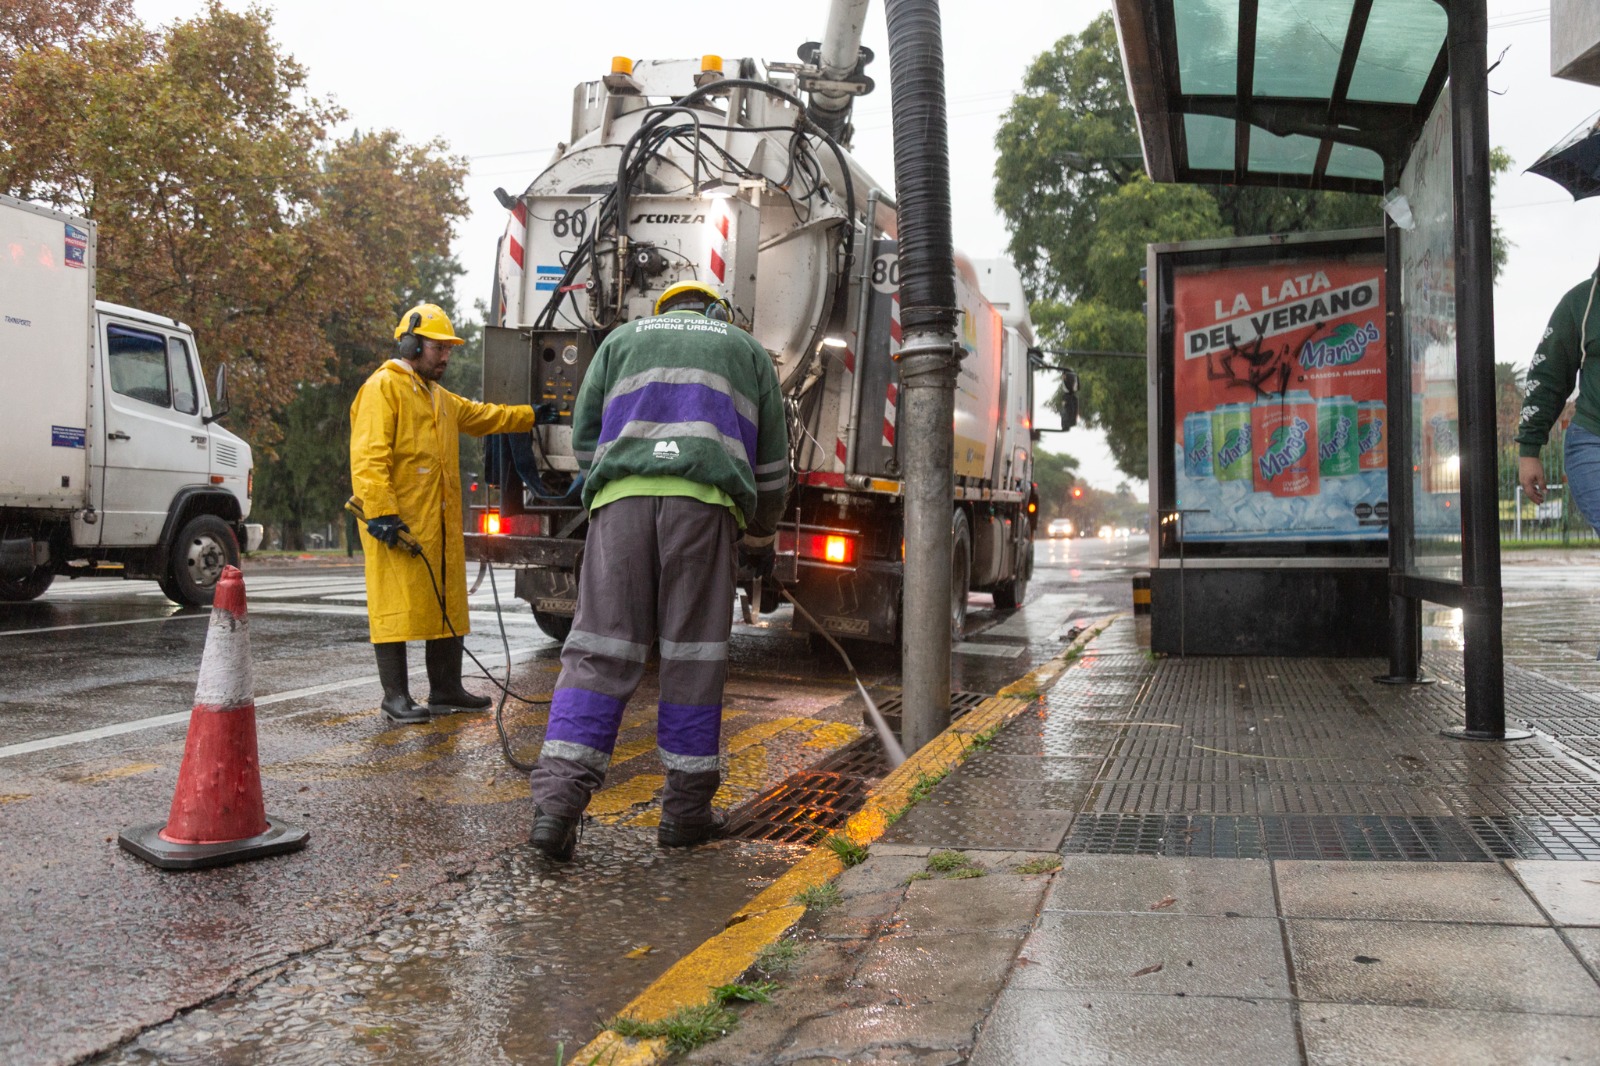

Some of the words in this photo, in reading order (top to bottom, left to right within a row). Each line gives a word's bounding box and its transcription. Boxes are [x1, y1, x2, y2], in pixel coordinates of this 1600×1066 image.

[553, 208, 587, 238] 80
[630, 213, 706, 225] SCORZA
[1215, 292, 1252, 321] LA
[1261, 270, 1332, 308] LATA
[635, 325, 642, 333] E
[686, 324, 728, 336] URBANA
[638, 317, 681, 325] ESPACIO
[684, 318, 728, 328] PUBLICO
[1190, 322, 1241, 355] DEL
[1251, 284, 1374, 336] VERANO
[1299, 320, 1380, 370] Manaos
[1343, 368, 1382, 377] ARGENTINA
[1259, 416, 1310, 480] Manaos
